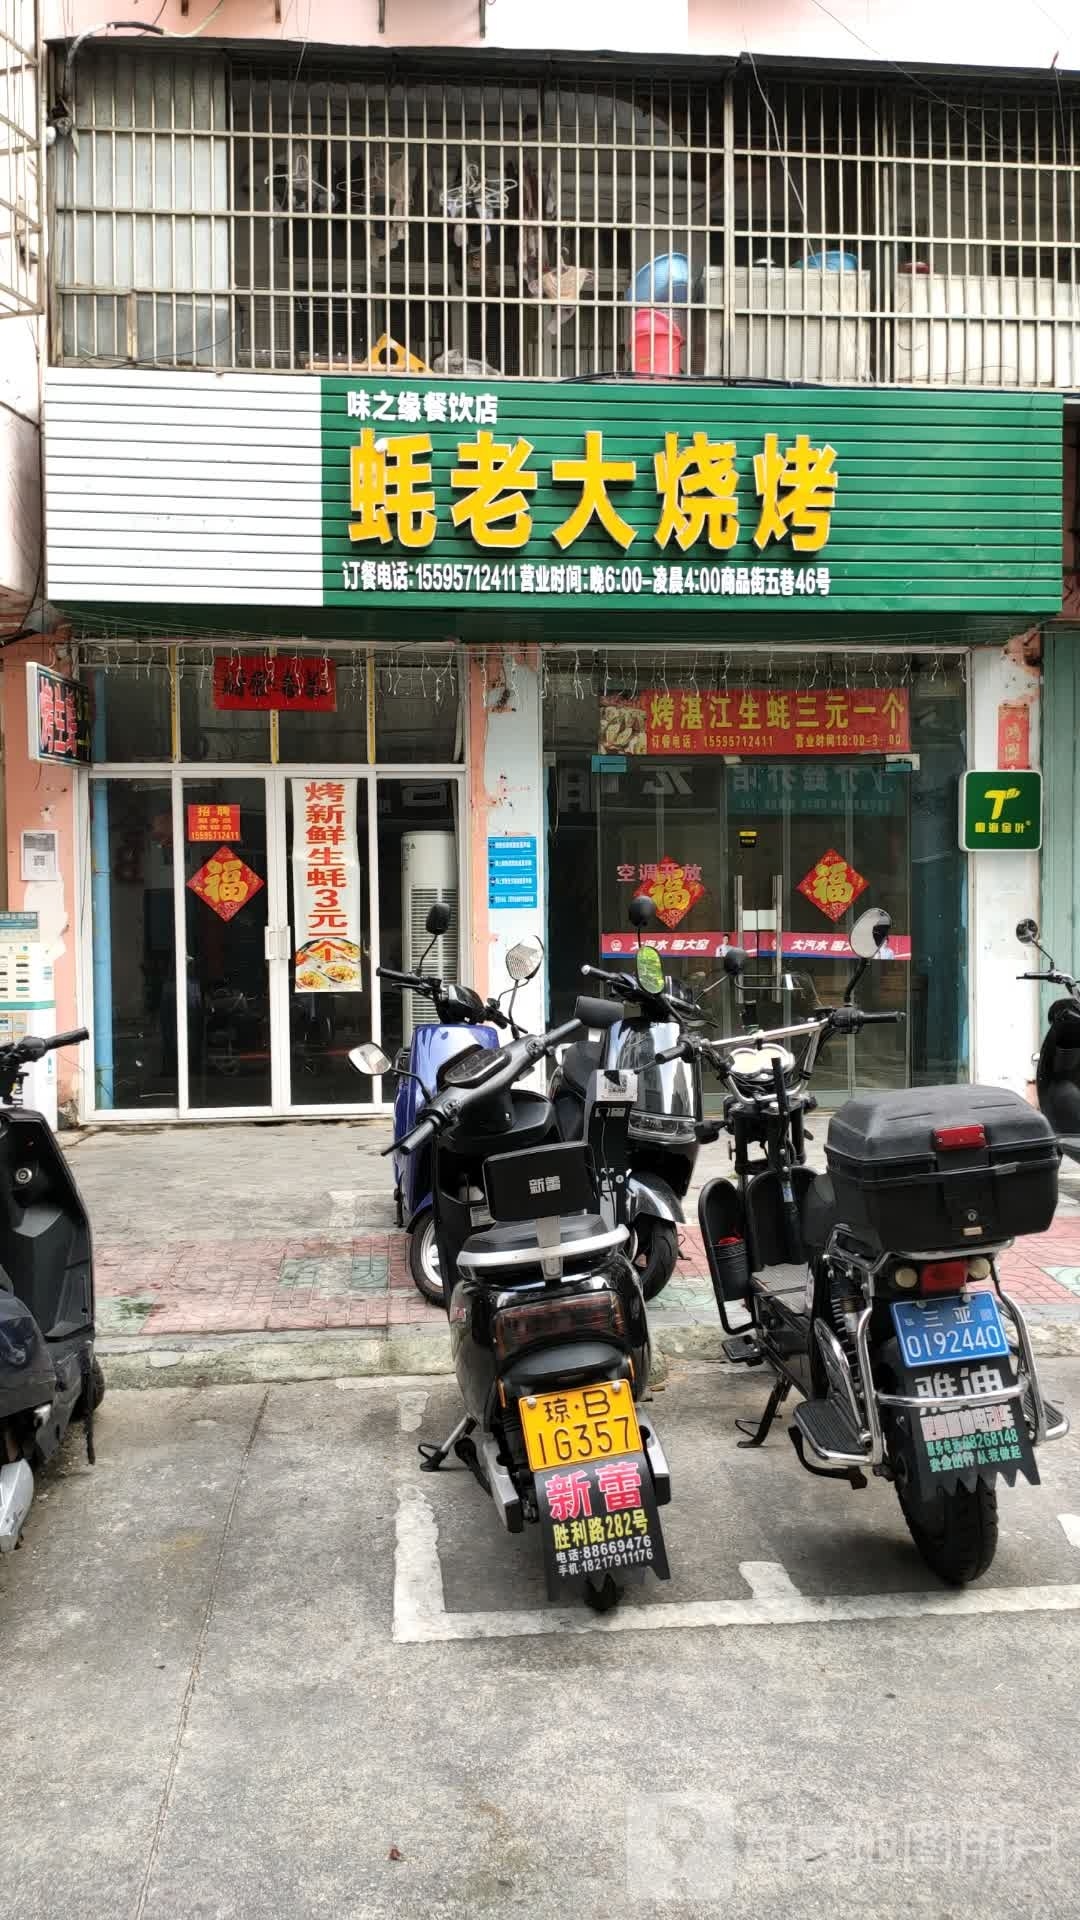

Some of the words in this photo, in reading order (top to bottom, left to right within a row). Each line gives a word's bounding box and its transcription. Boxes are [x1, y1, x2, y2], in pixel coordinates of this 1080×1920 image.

[347, 389, 499, 424] 味之缘餐饮店
[348, 427, 839, 551] 蚝老大烧烤
[650, 692, 905, 730] 烤湛江生蚝三元一个
[203, 859, 248, 904] 福
[305, 781, 348, 962] 烤新鲜生蚝3元一个
[813, 861, 854, 905] 福
[922, 1305, 976, 1330] 三亚
[906, 1324, 1001, 1358] 0192440
[536, 1416, 632, 1465] 1G357
[545, 1461, 642, 1523] 新蕾
[552, 1508, 649, 1550] 胜利路282号
[555, 1534, 652, 1565] 电话:88669476
